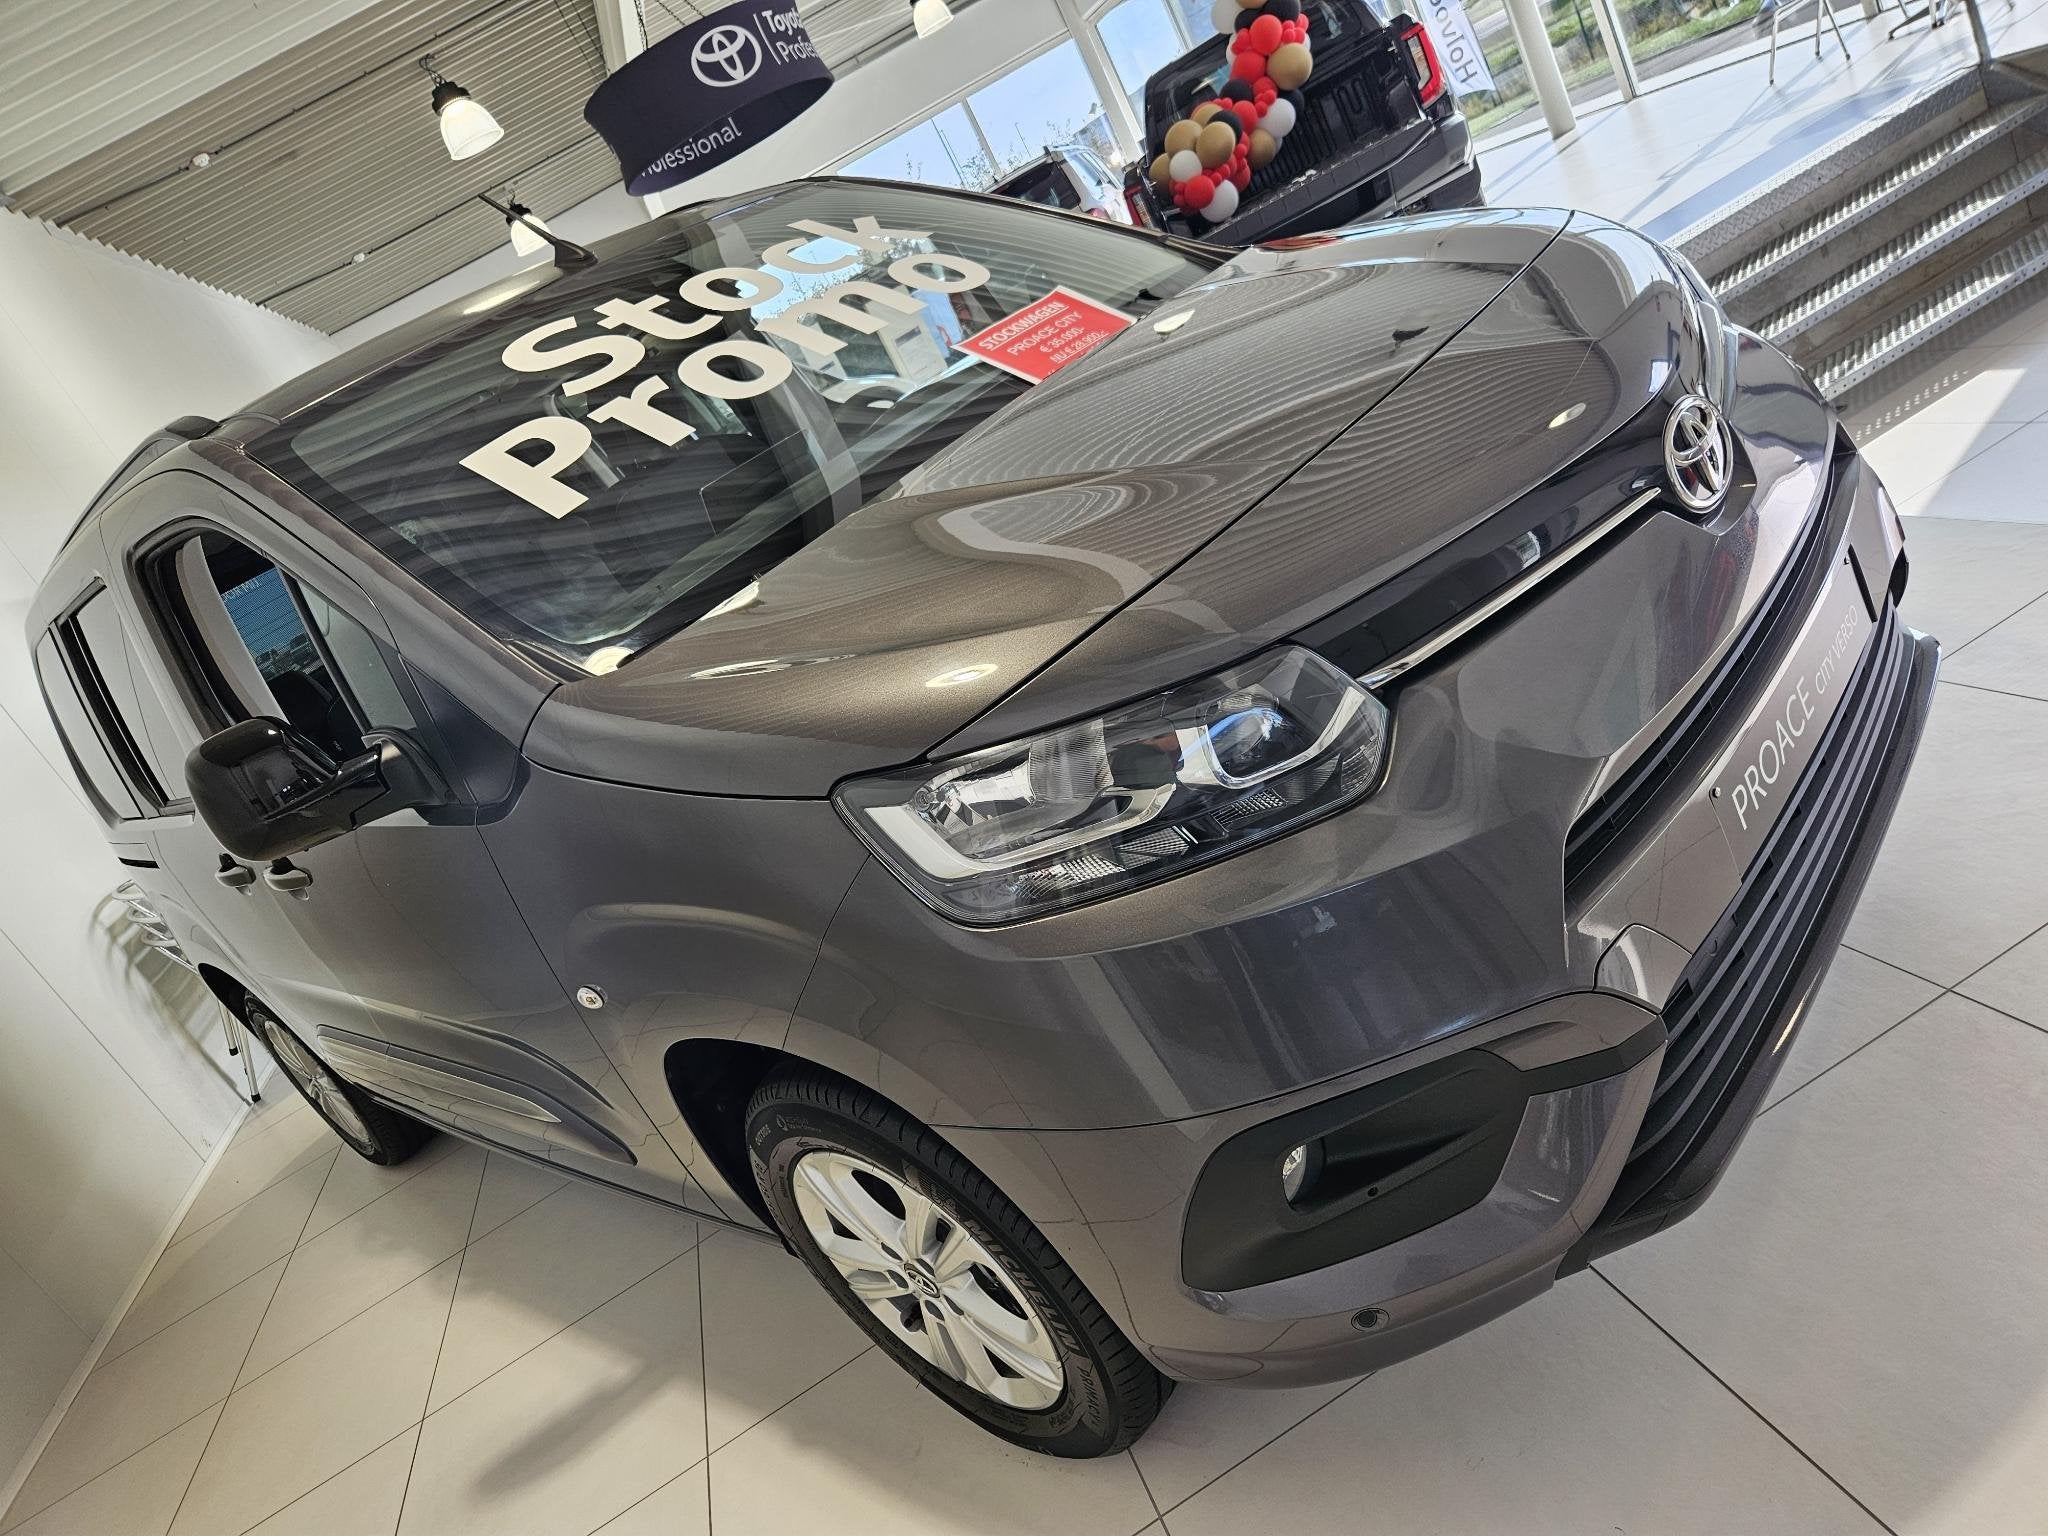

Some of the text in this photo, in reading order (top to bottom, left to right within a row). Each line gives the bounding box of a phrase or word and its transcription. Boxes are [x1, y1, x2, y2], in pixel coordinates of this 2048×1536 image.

[761, 7, 804, 36] Toyot
[775, 35, 819, 63] Profe
[501, 215, 934, 397] Stock
[978, 301, 1068, 350] STOCKWAGEN
[1007, 326, 1059, 356] PROACE
[1054, 310, 1083, 332] CITY
[458, 253, 991, 519] Promo
[1731, 605, 1858, 831] PROACE CITY VERSO
[965, 1218, 1082, 1352] MICHELIN
